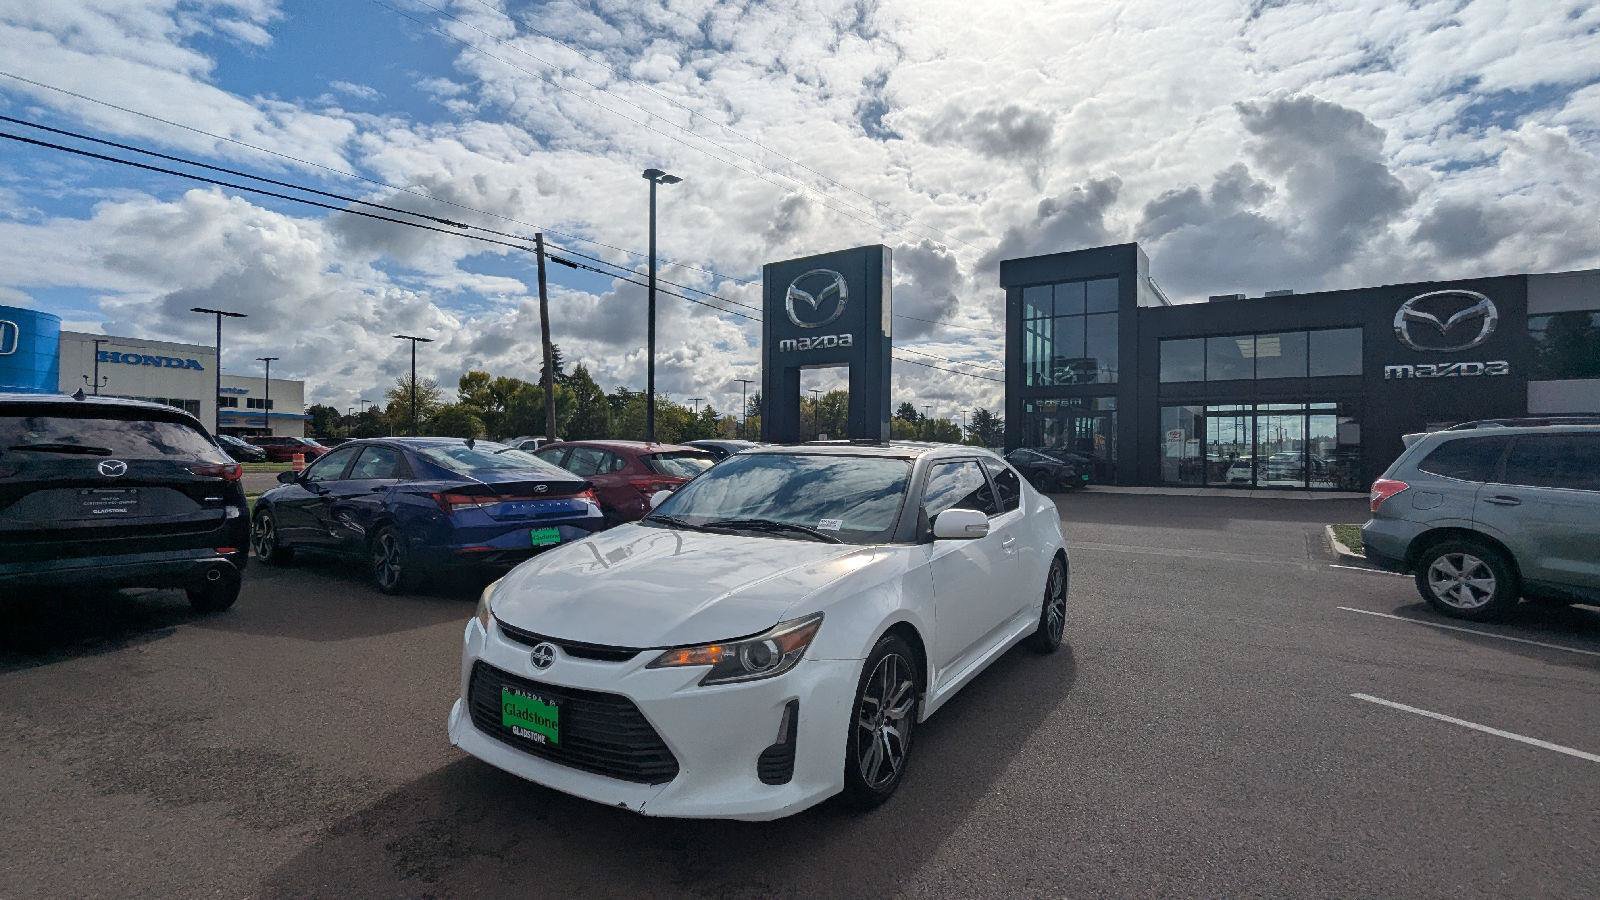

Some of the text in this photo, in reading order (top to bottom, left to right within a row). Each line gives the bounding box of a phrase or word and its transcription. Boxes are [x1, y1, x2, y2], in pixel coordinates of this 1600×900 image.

[98, 350, 204, 371] HONDA
[514, 688, 544, 704] MAZDA
[503, 702, 558, 731] Gladstone
[512, 726, 546, 744] GLADSTONE
